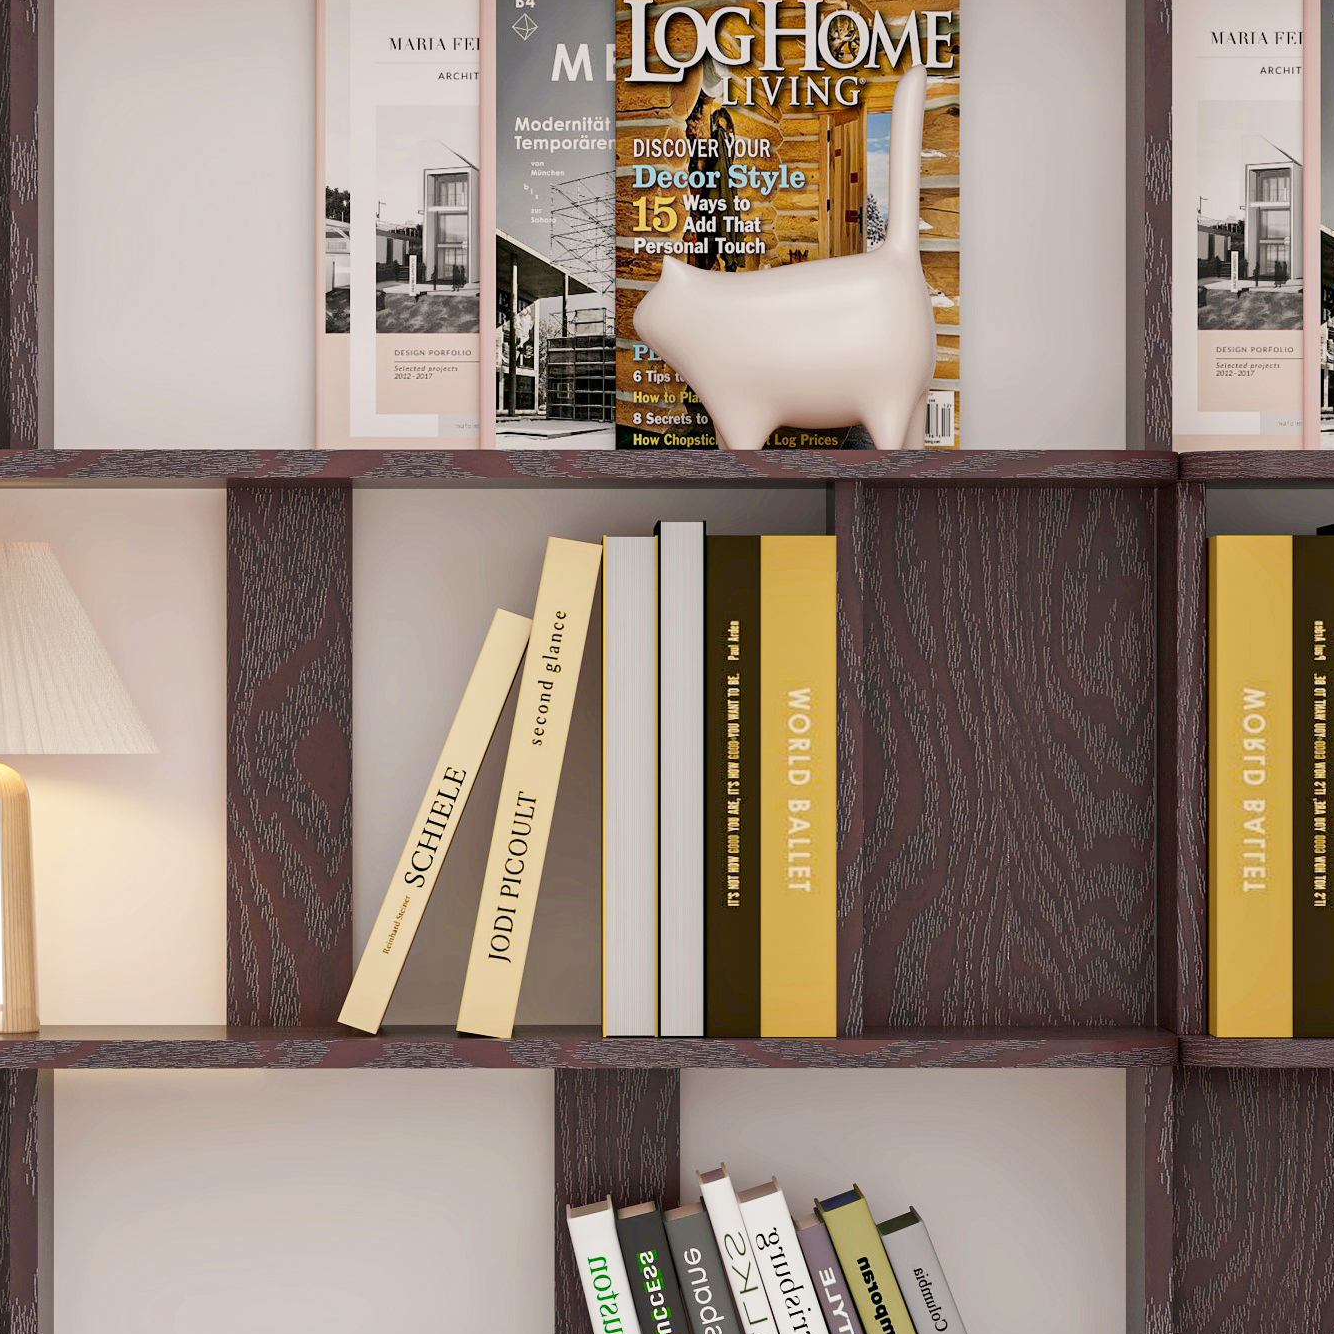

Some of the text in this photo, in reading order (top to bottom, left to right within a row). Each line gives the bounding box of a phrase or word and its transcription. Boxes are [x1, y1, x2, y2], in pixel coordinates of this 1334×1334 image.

[390, 37, 446, 51] MARIA
[438, 72, 480, 80] ARCHIT
[722, 76, 860, 106] LIVING
[514, 116, 611, 132] Modernität
[513, 134, 617, 154] Temporären
[633, 139, 770, 158] DISCOVER YOUR
[529, 168, 565, 177] München
[632, 165, 805, 195] Decor Style
[633, 196, 678, 232] 15
[683, 195, 750, 213] Ways to
[683, 216, 761, 232] Add That
[634, 238, 765, 254] Personal Touch
[393, 365, 458, 375] Selected projects
[726, 620, 741, 662] Paul Arden
[532, 610, 567, 746] second glance
[788, 688, 811, 892] WORLD BALLET
[405, 766, 467, 888] SCHIELE
[488, 790, 537, 964] JODI PICOULT
[382, 895, 411, 955] Reinhard Steiner
